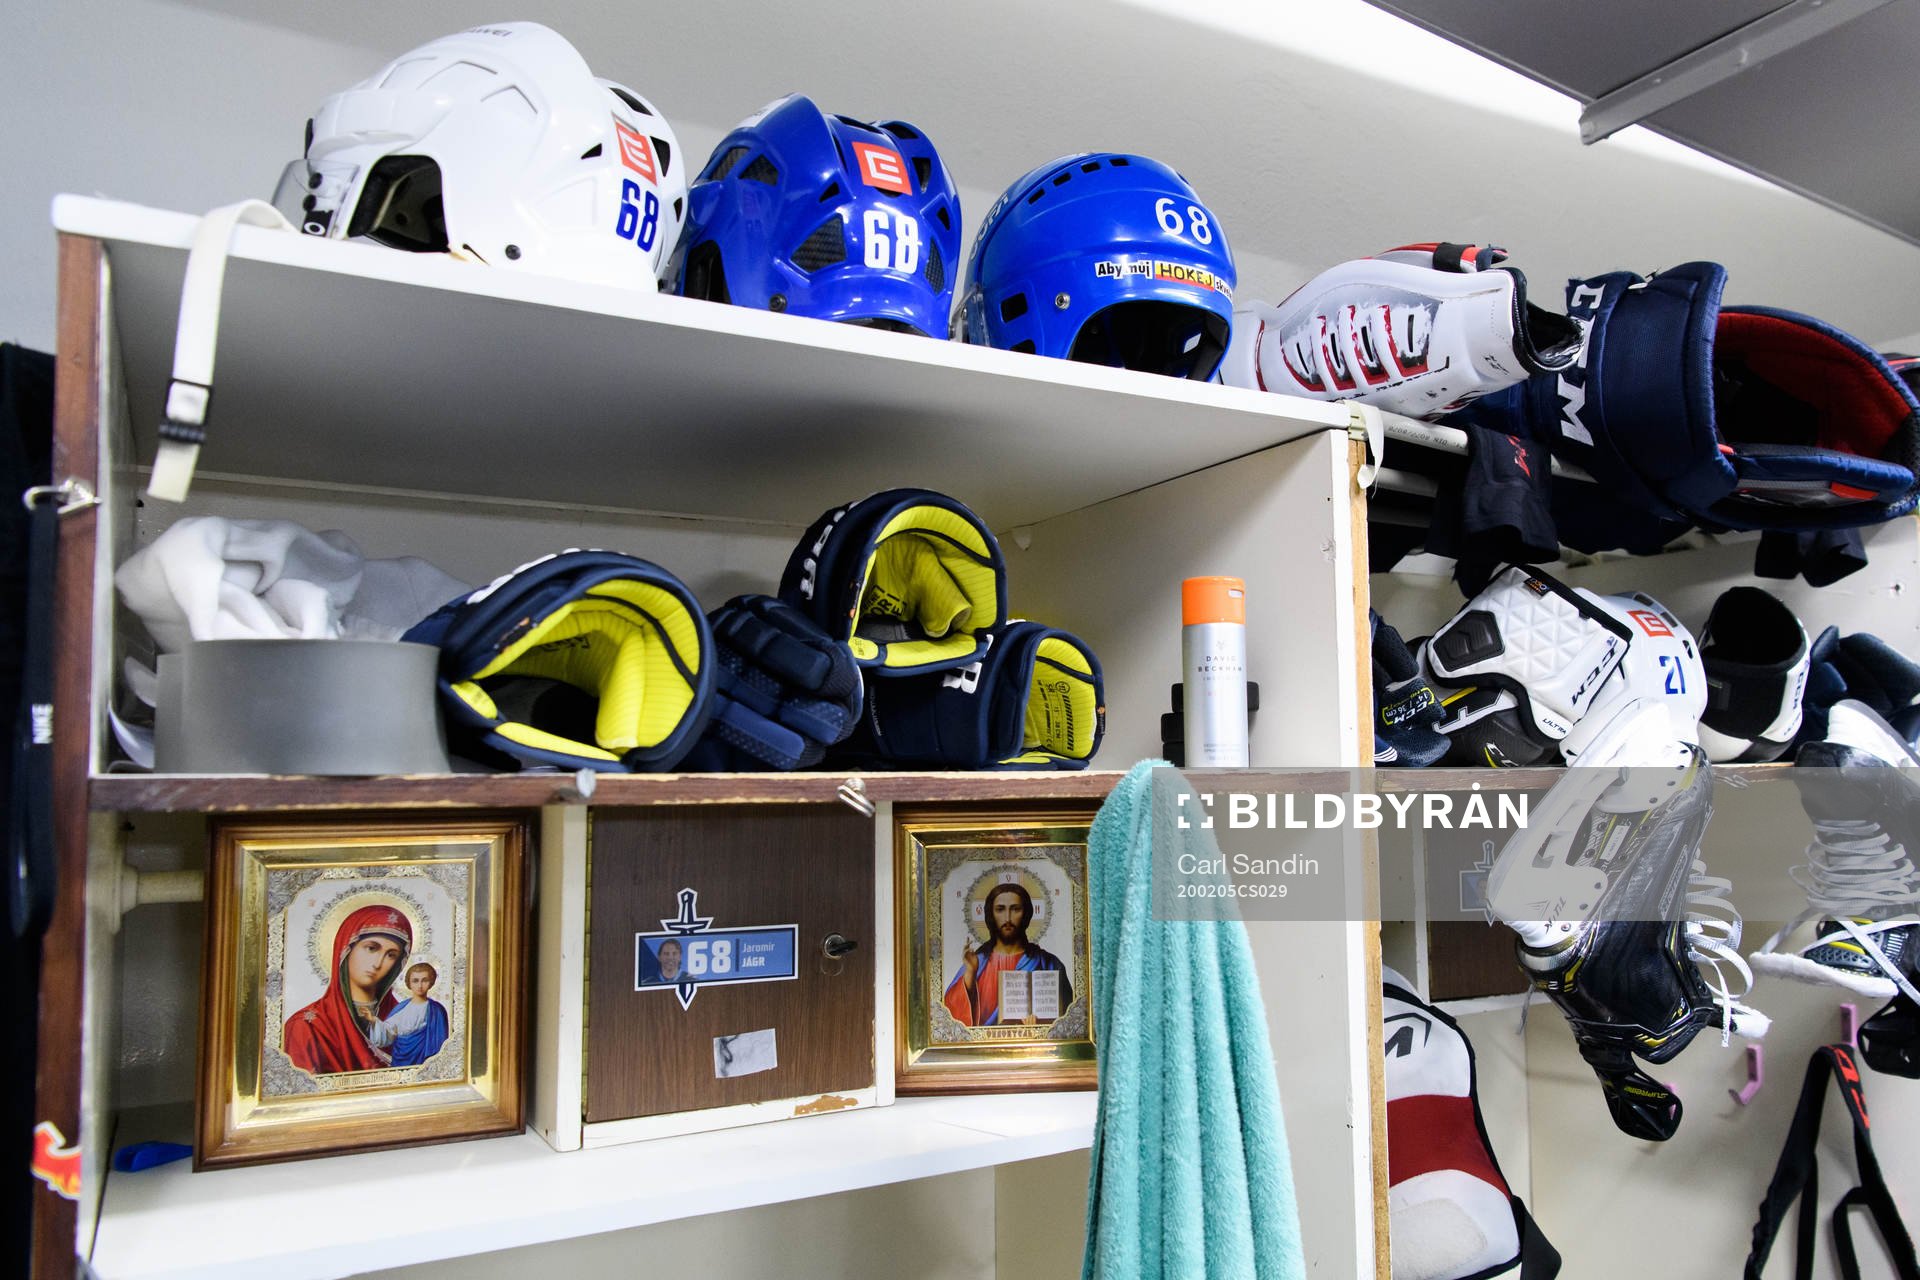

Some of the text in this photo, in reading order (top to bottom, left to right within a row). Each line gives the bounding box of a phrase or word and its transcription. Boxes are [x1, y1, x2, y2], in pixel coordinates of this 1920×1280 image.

[615, 178, 659, 253] 68
[1155, 197, 1213, 245] 68
[863, 209, 918, 275] 68
[1097, 263, 1122, 279] Aby
[1160, 262, 1213, 287] HOKEJ
[1571, 647, 1617, 706] CCM
[1658, 655, 1687, 695] 21
[31, 703, 54, 745] NIKE
[1061, 694, 1075, 752] WARRIOR
[1393, 701, 1428, 725] CCM
[1542, 717, 1568, 736] ULTRA
[687, 940, 732, 975] 68
[741, 954, 766, 968] JÁGR
